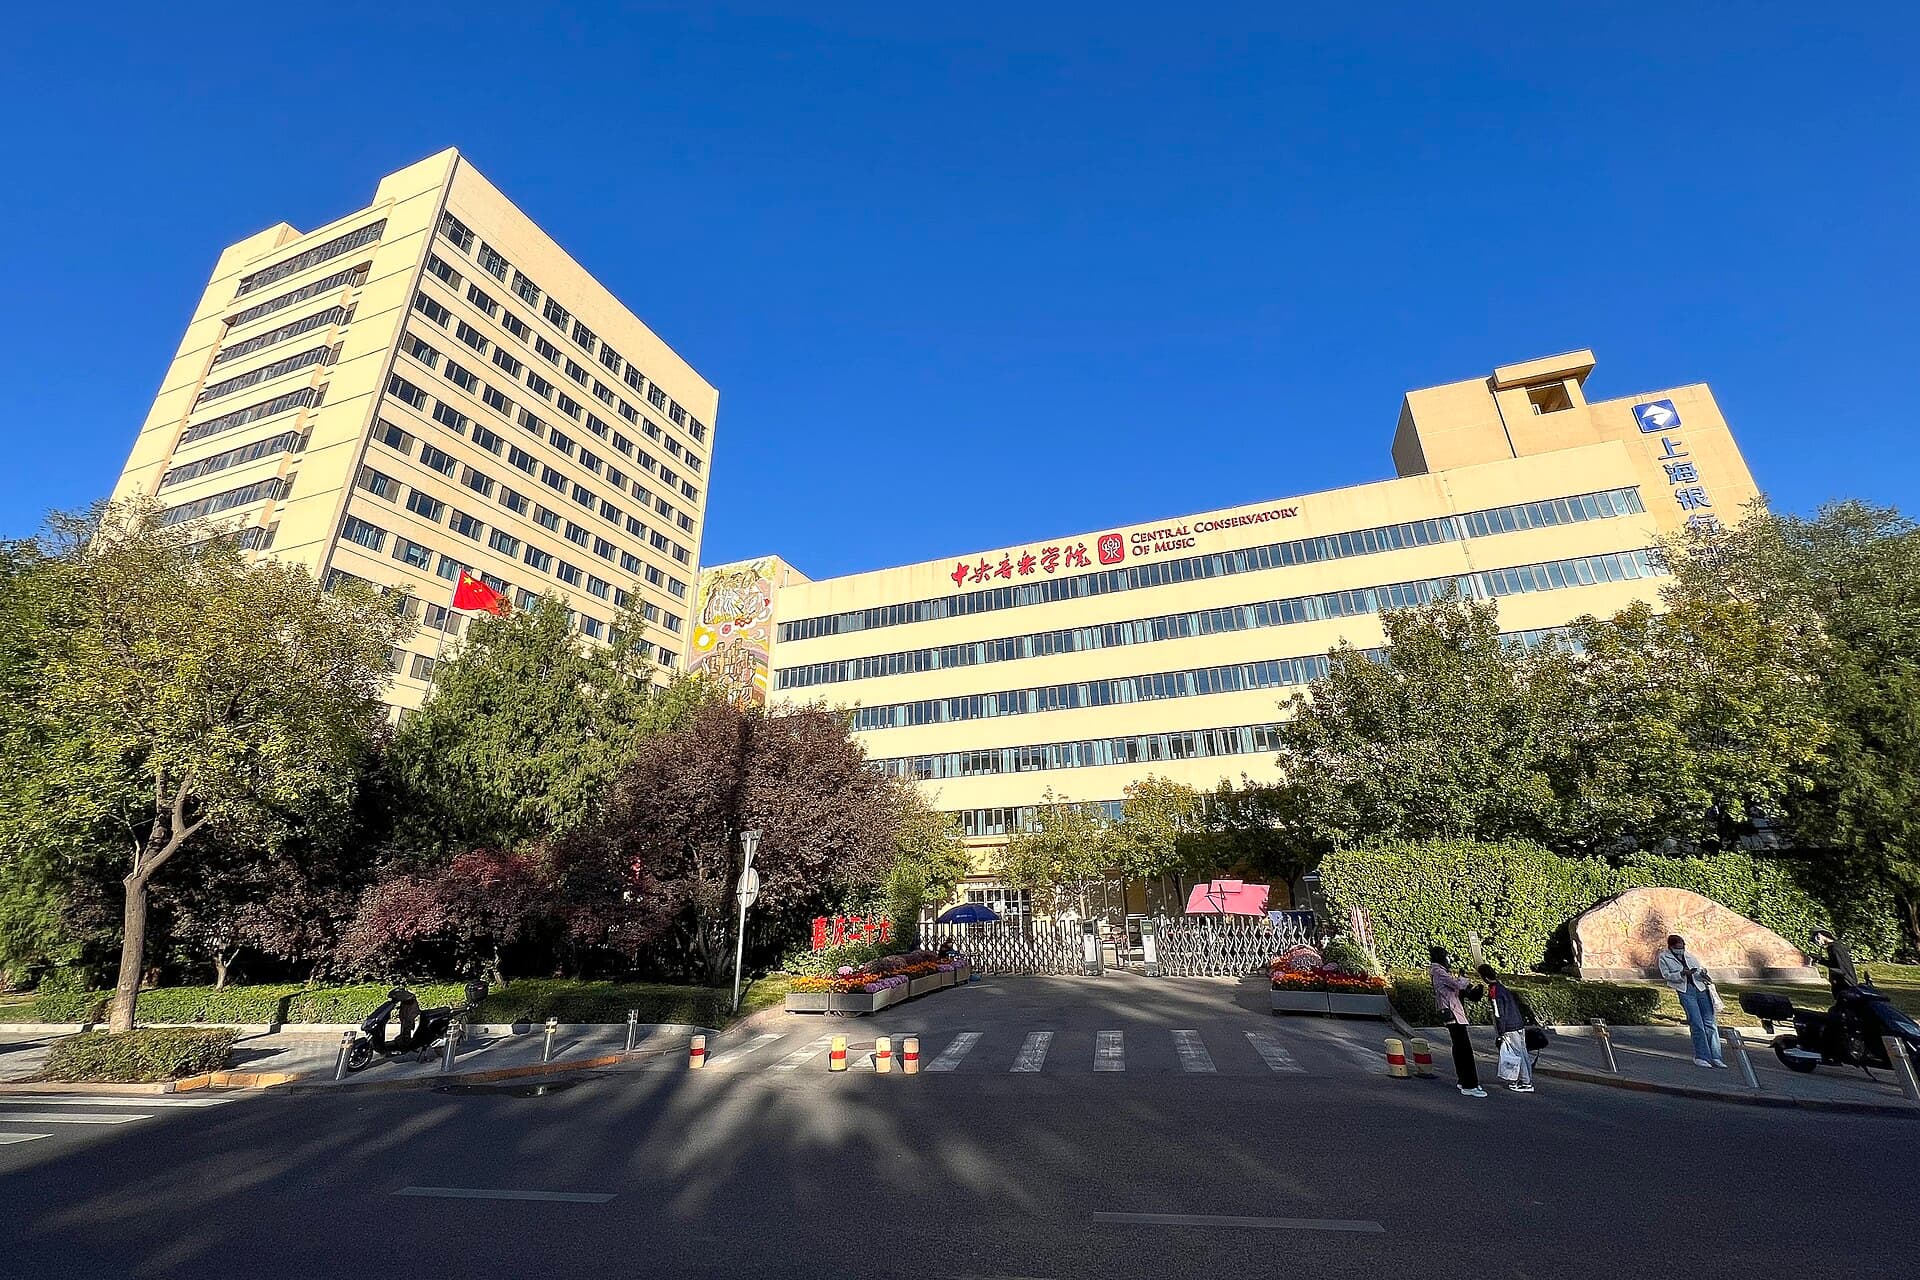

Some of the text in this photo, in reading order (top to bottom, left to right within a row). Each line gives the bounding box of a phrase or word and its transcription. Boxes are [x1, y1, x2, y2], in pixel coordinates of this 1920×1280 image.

[1131, 507, 1298, 543] CENTRAL CONSERVATORY
[1154, 537, 1197, 552] MUSIC
